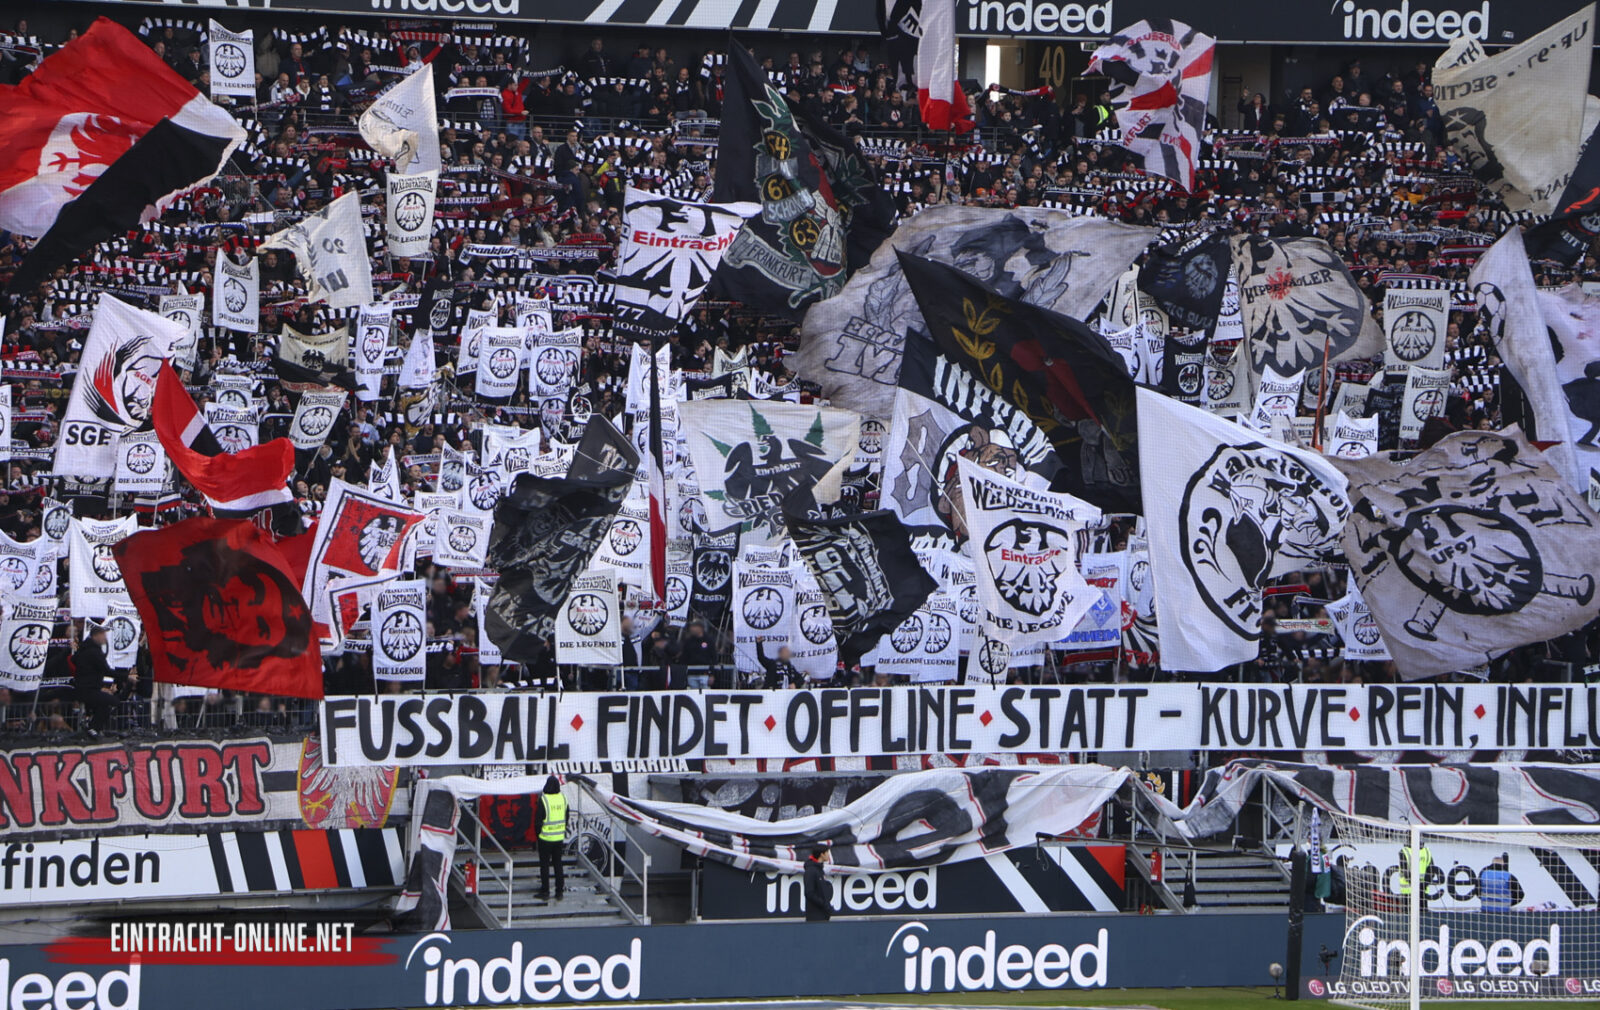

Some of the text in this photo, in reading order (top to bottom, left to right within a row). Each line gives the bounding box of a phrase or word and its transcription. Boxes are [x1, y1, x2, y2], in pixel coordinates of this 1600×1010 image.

[967, 0, 1113, 34] indeed
[1342, 0, 1490, 40] indeed
[1039, 46, 1065, 87] 40
[633, 230, 735, 252] Eintracht
[792, 218, 819, 247] 63
[750, 243, 807, 285] FRANKFURT
[616, 304, 646, 321] 77
[1386, 293, 1444, 313] WALDSTADION
[65, 423, 113, 447] SGE
[755, 462, 801, 477] EINTRACHT
[1430, 535, 1477, 565] UF97
[613, 558, 643, 569] LEGENDE
[738, 572, 794, 588] WALDSTADION
[377, 592, 424, 612] WALDSTADION
[986, 591, 1075, 634] DIE LEGENDE
[20, 636, 48, 646] Eintracht
[388, 626, 417, 635] Eintracht
[1061, 628, 1121, 643] ANNHEIM
[560, 640, 617, 648] DIE LEGENDE
[376, 666, 424, 676] DIE LEGENDE
[878, 657, 890, 665] DIE
[923, 659, 957, 667] LEGENDE
[324, 694, 570, 765] FUSSBALL
[597, 692, 763, 759] FINDET
[786, 688, 976, 753] OFFLINE
[998, 687, 1149, 748] STATT
[1159, 709, 1182, 718] -
[1200, 687, 1347, 749] KURVE
[1368, 686, 1480, 749] REIN,
[611, 759, 690, 773] GUARDIA
[1, 840, 161, 890] finden
[766, 864, 938, 912] ineed
[903, 928, 1108, 993] indeed
[1359, 923, 1560, 977] indeed
[0, 954, 142, 1010] eed
[424, 937, 642, 1006] indeed
[1326, 981, 1347, 995] LG
[1352, 981, 1389, 994] OLED
[1454, 979, 1540, 994] LG OLED TV
